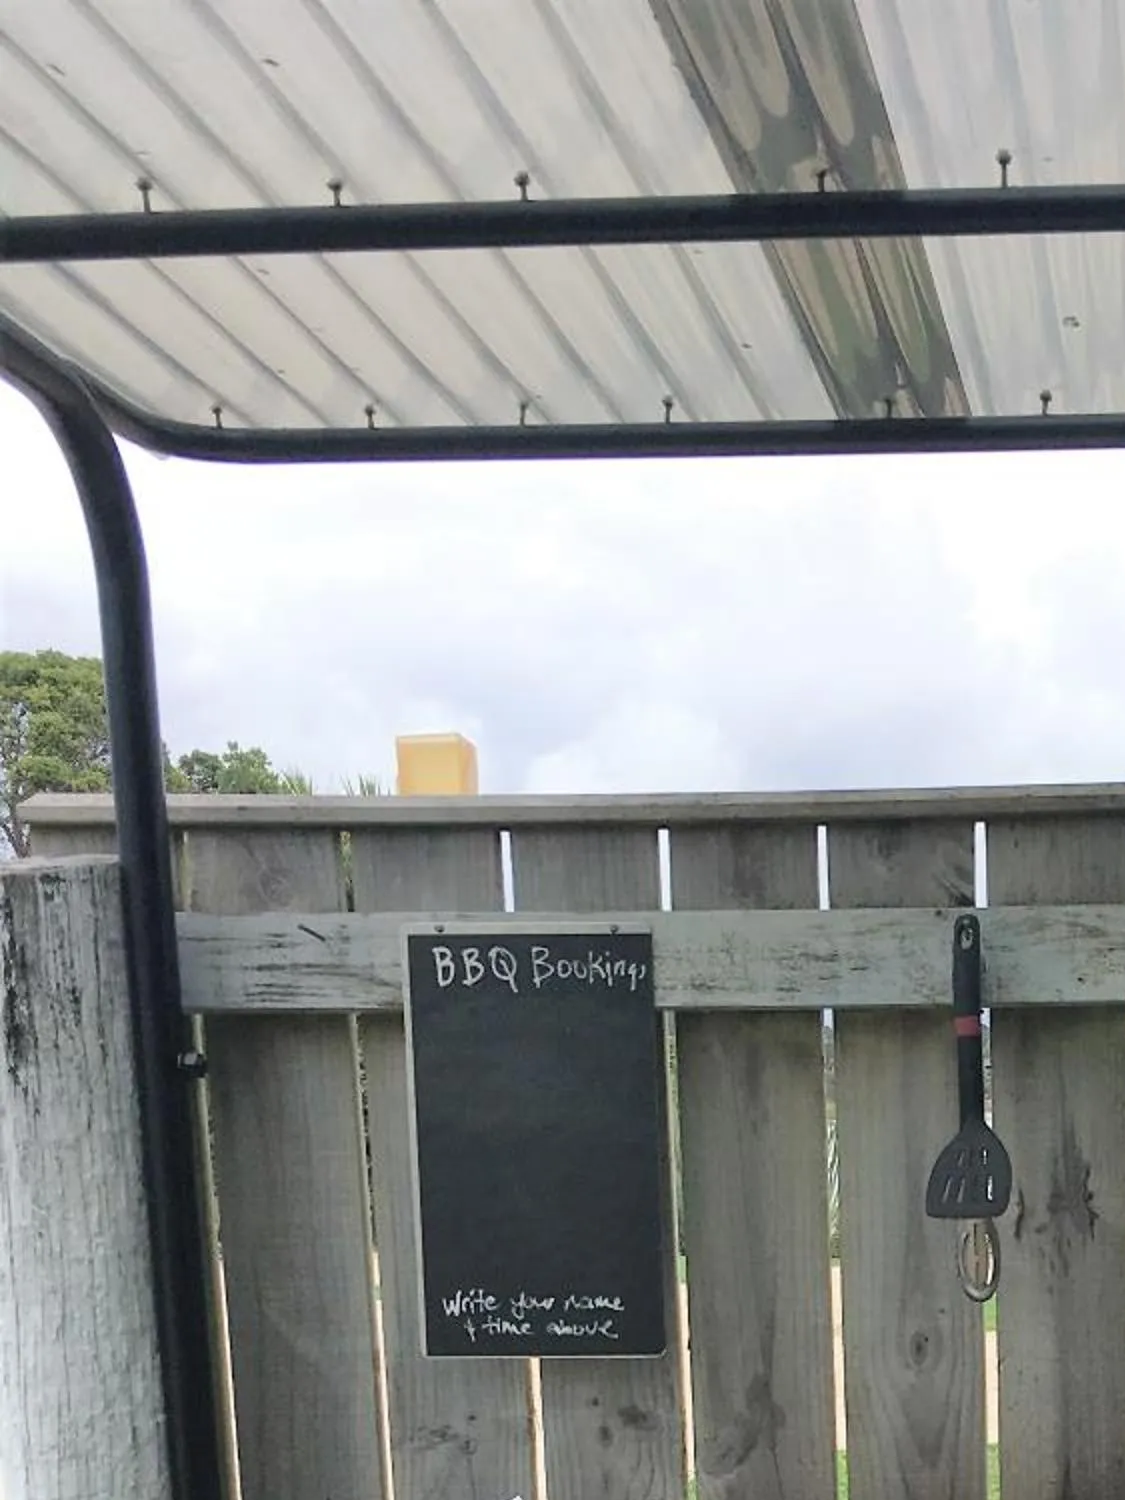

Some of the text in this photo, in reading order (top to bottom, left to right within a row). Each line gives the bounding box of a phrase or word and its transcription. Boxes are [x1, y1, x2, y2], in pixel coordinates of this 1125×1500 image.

[432, 946, 518, 993] BBQ
[442, 1290, 625, 1320] Write your name
[482, 1314, 534, 1336] time
[547, 1319, 619, 1339] above
